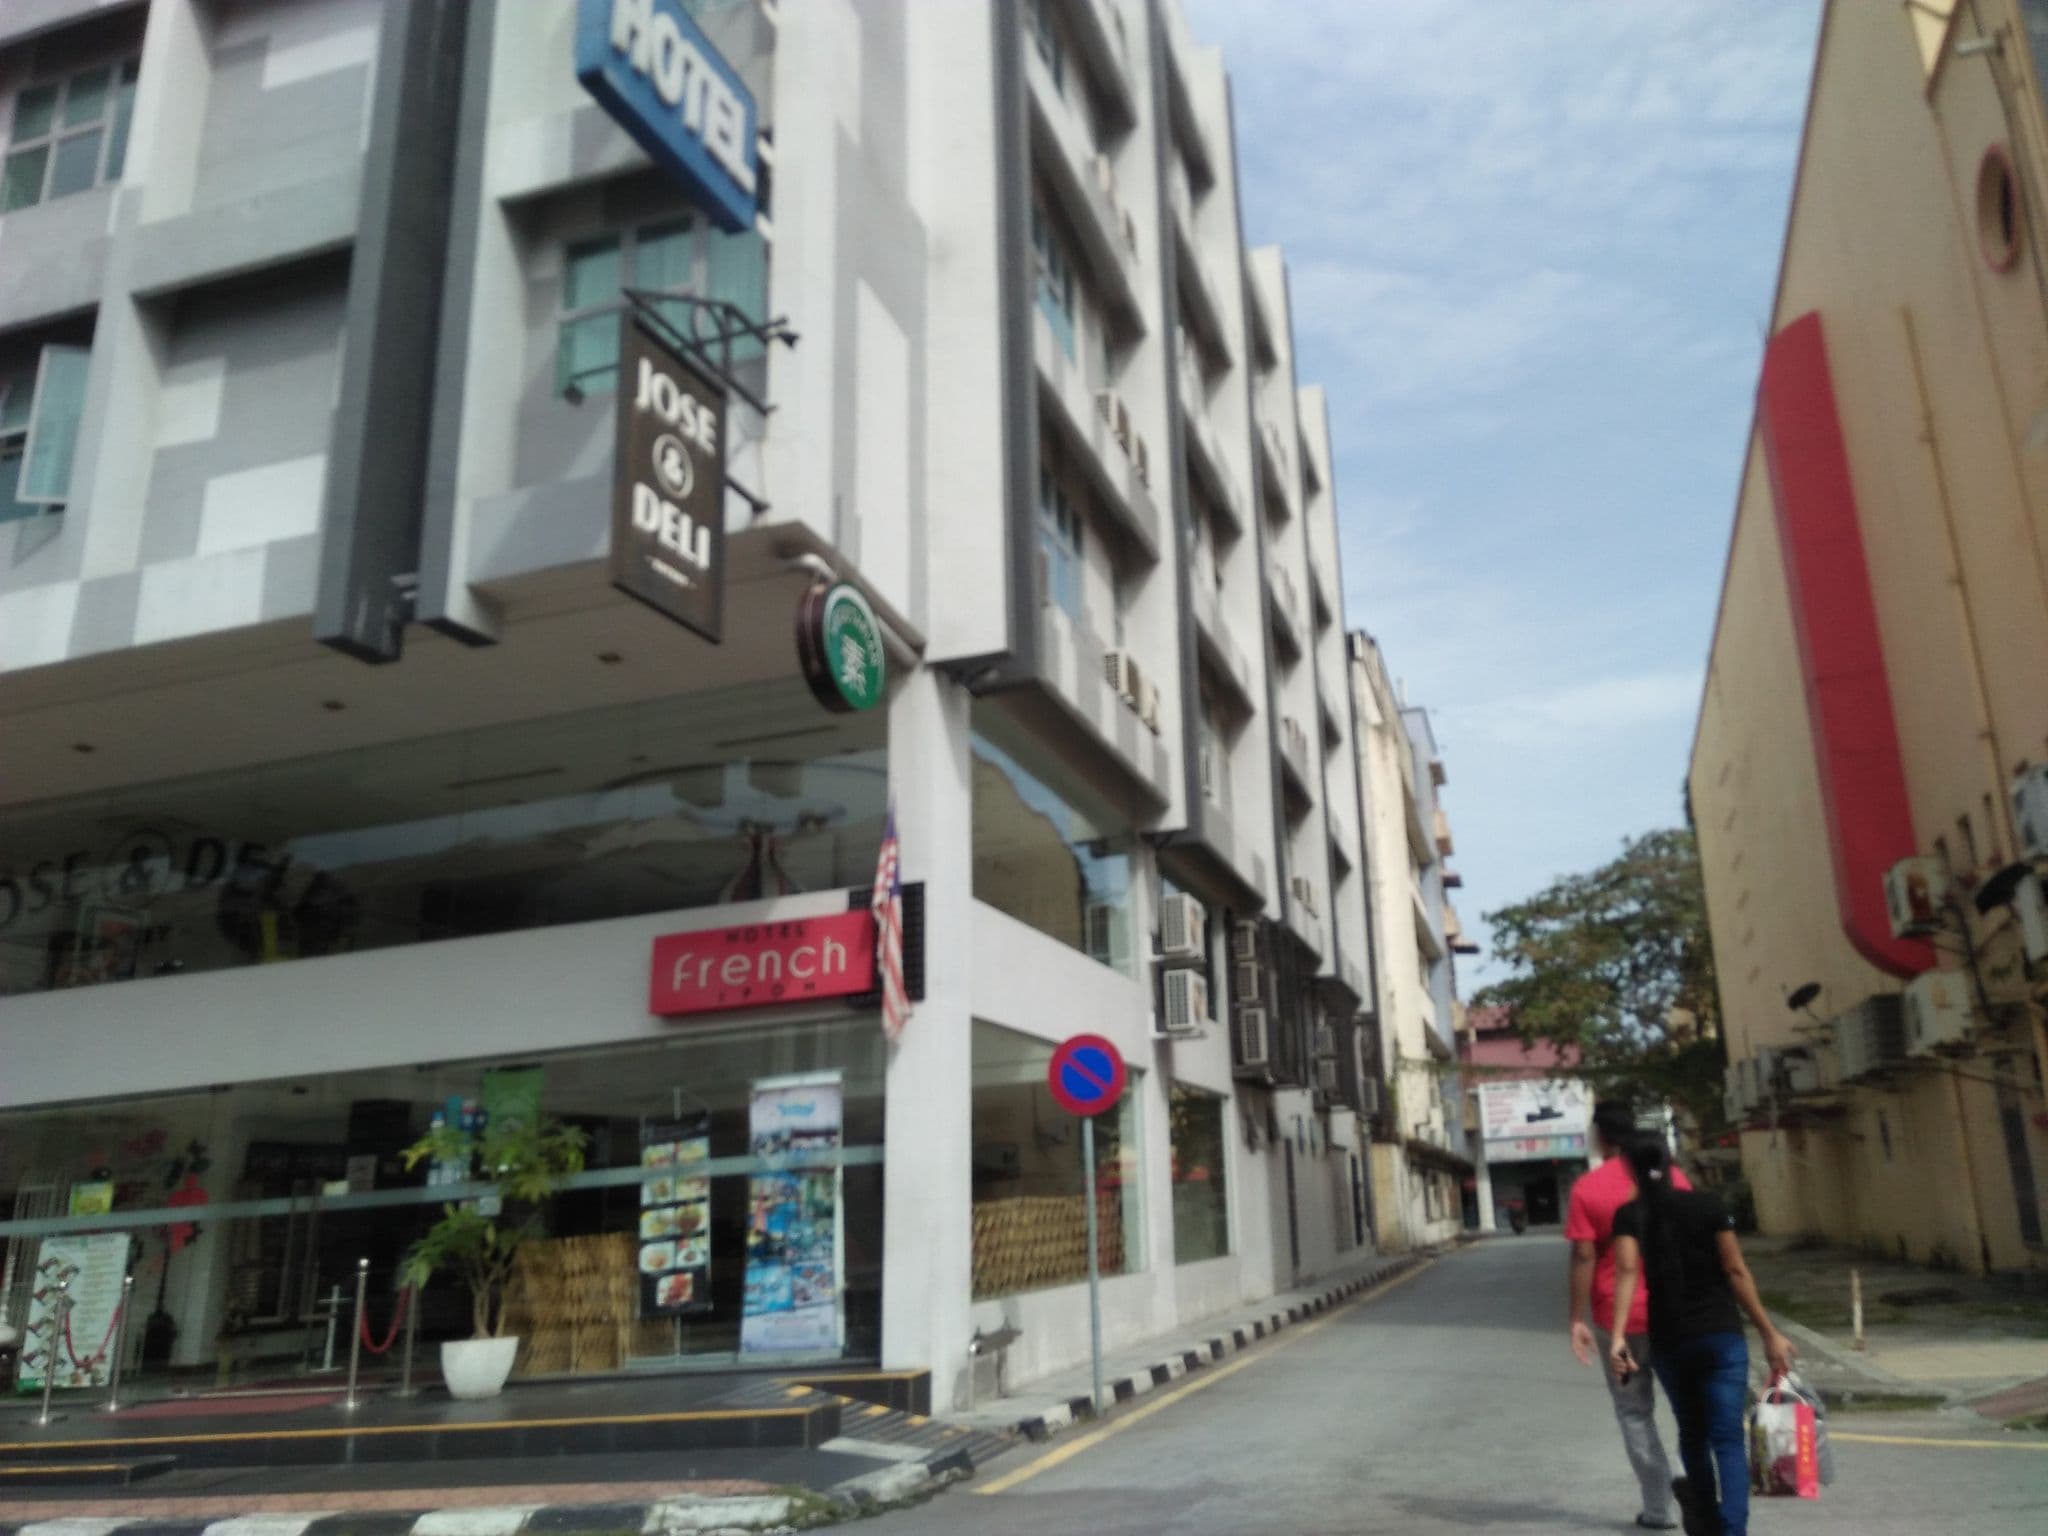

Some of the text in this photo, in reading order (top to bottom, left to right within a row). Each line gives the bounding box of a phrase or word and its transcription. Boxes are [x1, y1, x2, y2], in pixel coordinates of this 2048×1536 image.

[610, 0, 756, 193] HOTEL
[635, 357, 717, 458] JOSE
[632, 481, 711, 570] DELI
[672, 935, 847, 992] french
